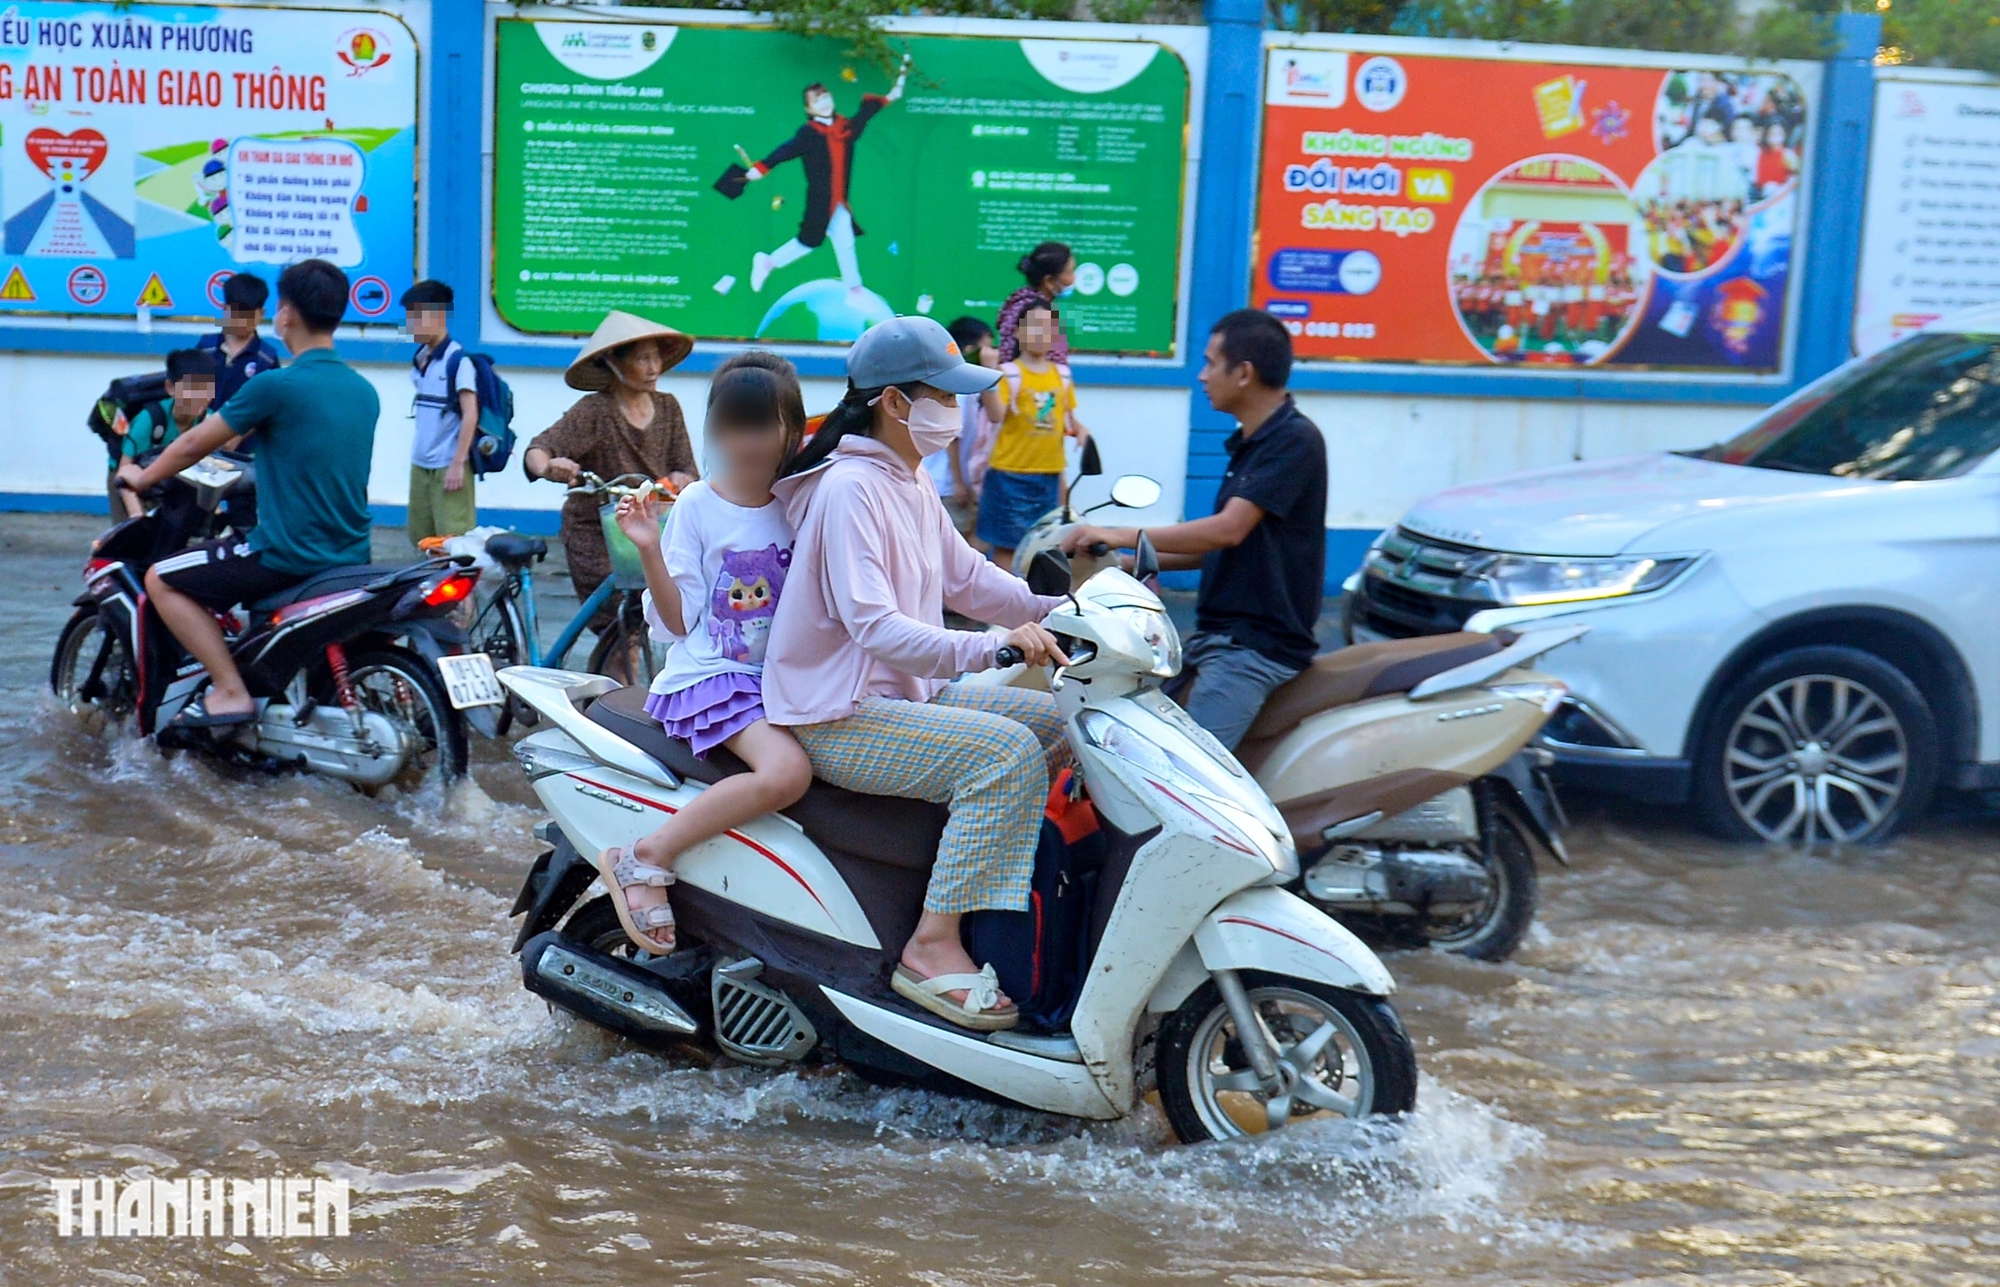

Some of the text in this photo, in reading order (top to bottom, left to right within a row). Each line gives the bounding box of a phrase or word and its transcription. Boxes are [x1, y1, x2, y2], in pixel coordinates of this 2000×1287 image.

[39, 22, 82, 53] HỌC
[92, 18, 152, 49] XUÂN
[162, 25, 253, 53] PHƯƠNG
[24, 65, 61, 101] AN
[73, 59, 146, 104] TOÀN
[158, 69, 222, 108] GIAO
[233, 65, 325, 111] THÔNG
[1304, 131, 1471, 159] KHÔNG NGỪNG
[1287, 160, 1449, 196] ĐỔI MỚI VÀ
[1304, 201, 1433, 235] SÁNG TẠO
